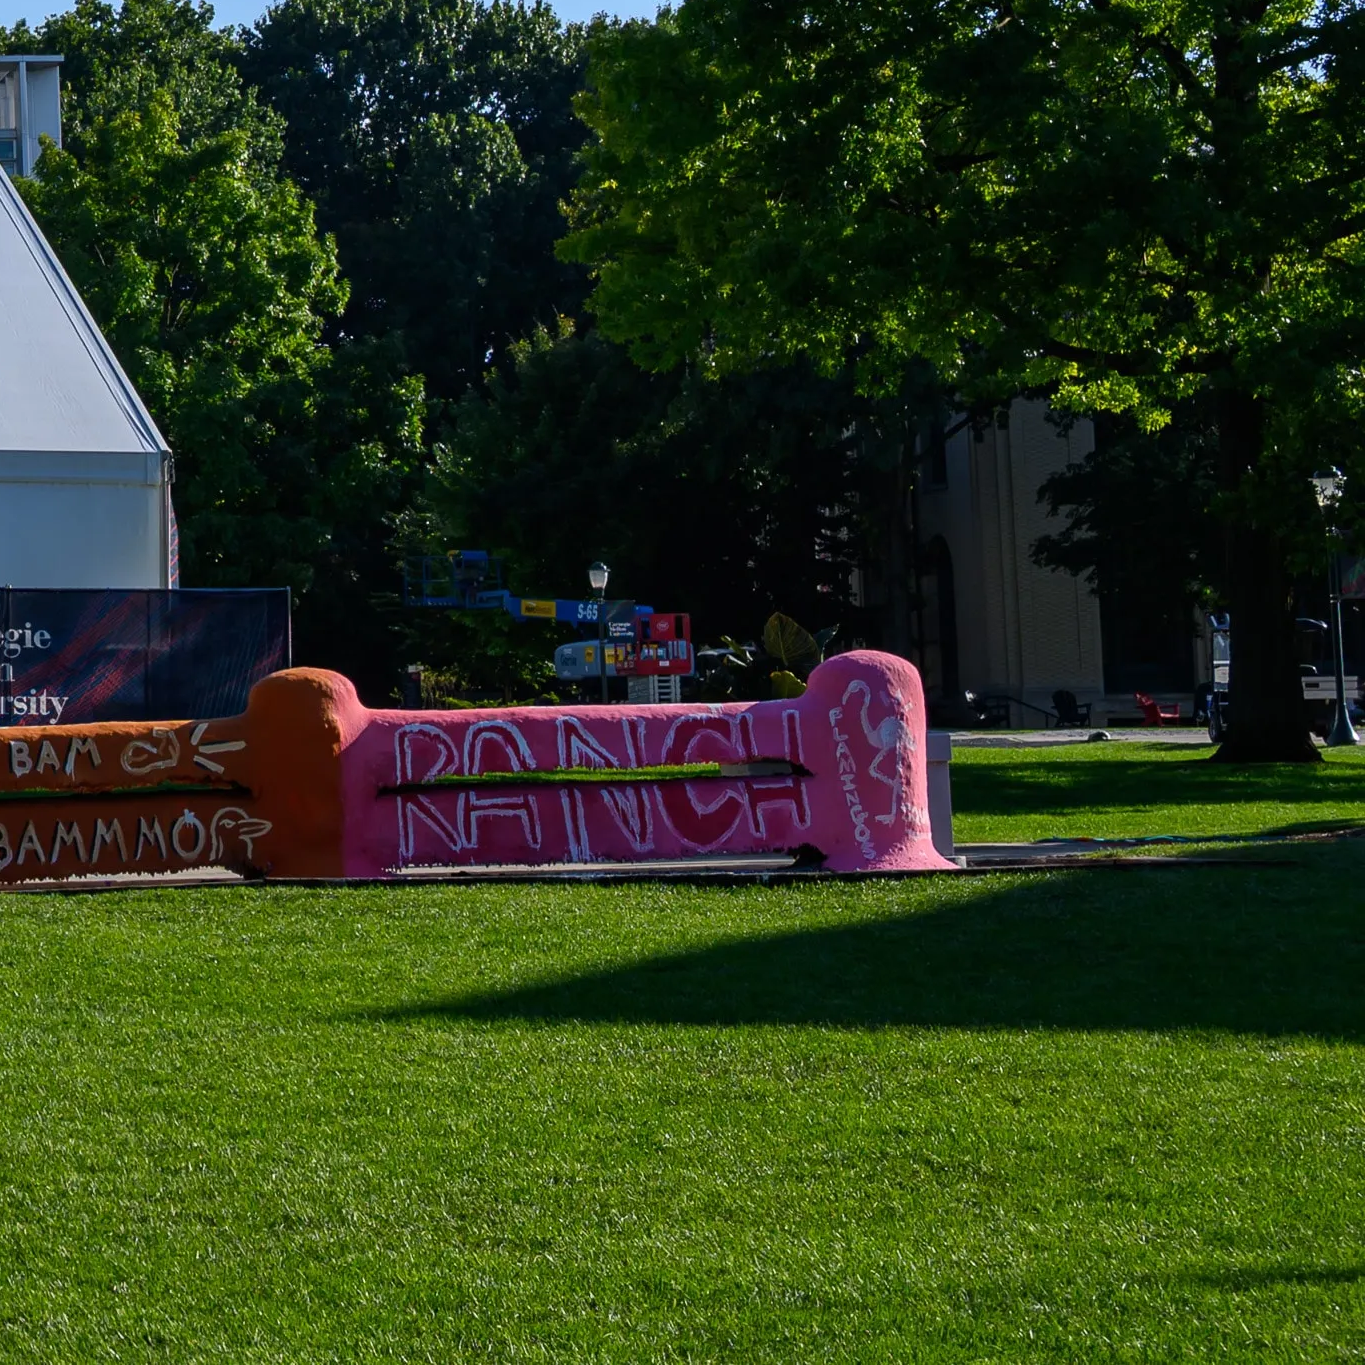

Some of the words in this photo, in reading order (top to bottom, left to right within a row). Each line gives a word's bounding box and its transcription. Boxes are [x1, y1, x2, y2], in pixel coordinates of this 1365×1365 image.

[577, 602, 599, 621] S-65
[9, 737, 102, 779] BAM
[393, 708, 812, 866] RANCH
[828, 706, 877, 860] FLAMINGOS
